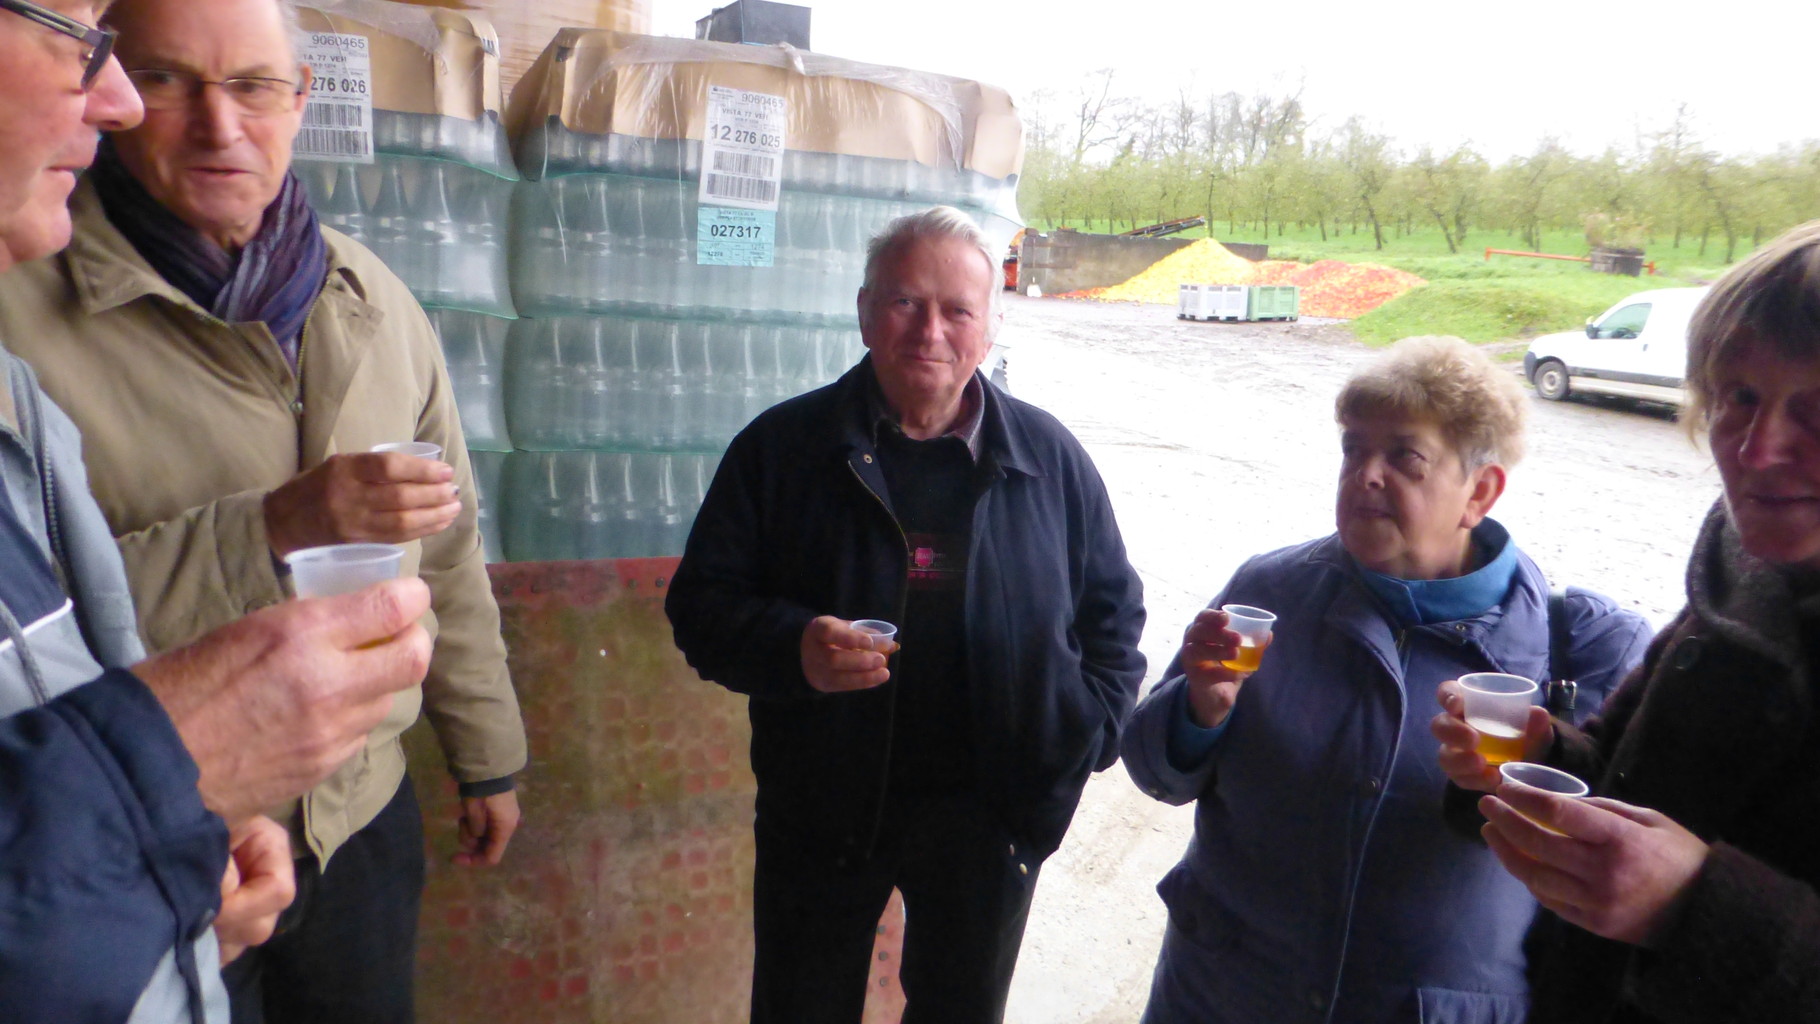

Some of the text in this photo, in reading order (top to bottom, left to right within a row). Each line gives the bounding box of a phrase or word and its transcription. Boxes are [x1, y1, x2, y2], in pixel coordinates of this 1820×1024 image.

[312, 35, 365, 48] 9060465
[310, 76, 366, 93] 276 026
[741, 93, 785, 108] 9060465
[710, 123, 781, 148] 12 276 025
[711, 224, 762, 238] 027317
